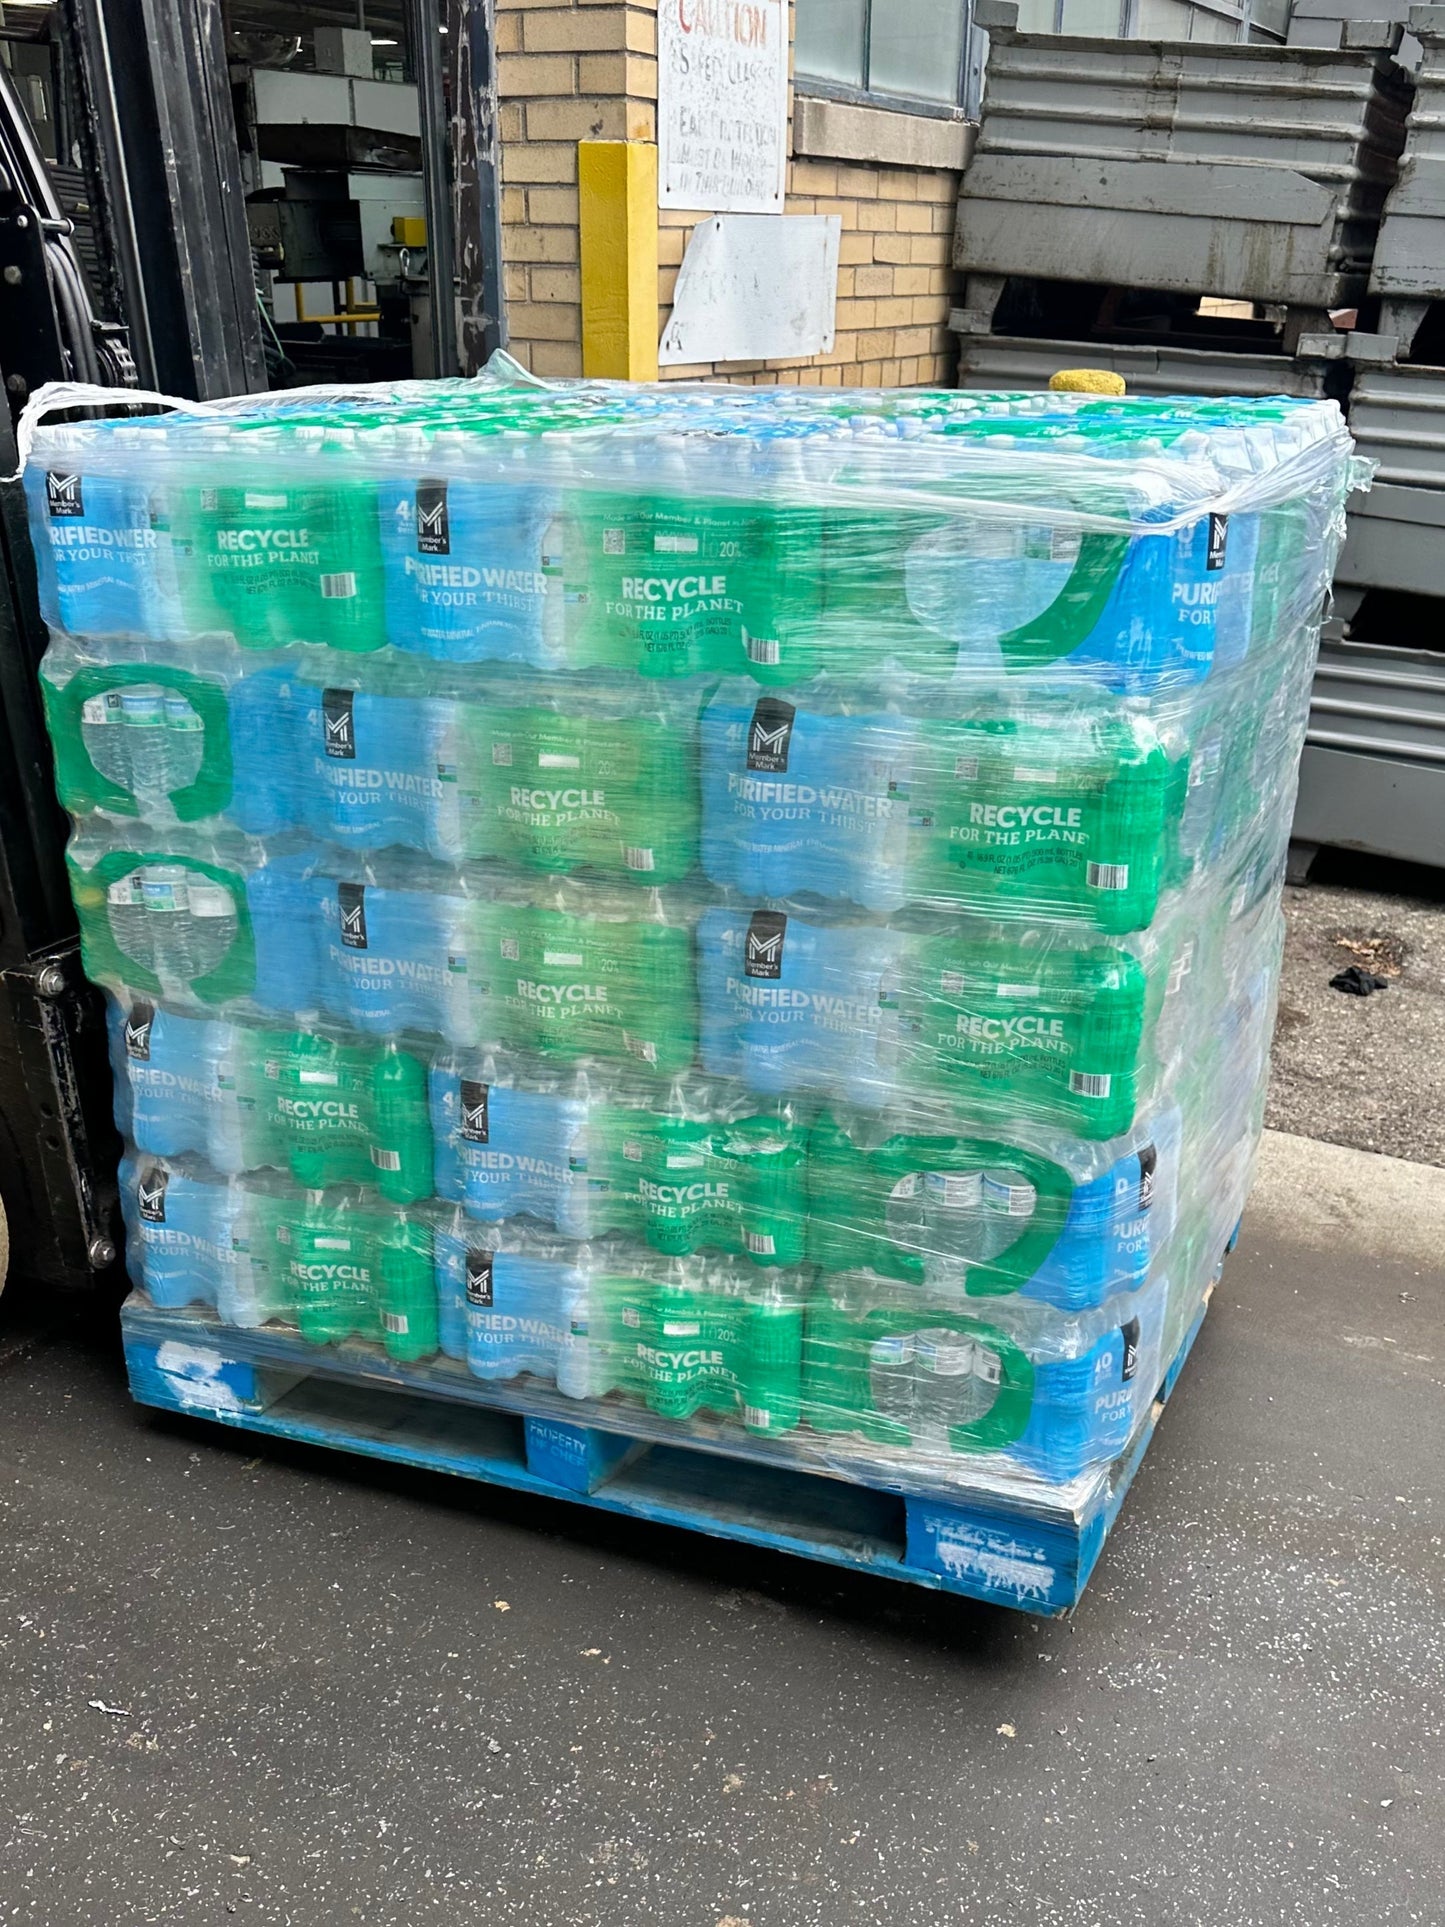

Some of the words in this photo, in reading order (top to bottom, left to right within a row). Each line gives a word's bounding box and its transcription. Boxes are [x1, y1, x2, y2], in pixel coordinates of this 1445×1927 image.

[679, 0, 767, 49] CAUTION
[655, 512, 692, 523] Member
[703, 518, 730, 527] Planet
[217, 528, 309, 551] RECYCLE
[419, 535, 447, 544] ember's
[422, 543, 438, 552] Mark
[67, 548, 114, 562] YOUR
[207, 553, 229, 567] FOR
[231, 553, 264, 567] THE
[268, 551, 319, 566] PLANET
[482, 568, 548, 594] WATER
[622, 576, 727, 601] RECYCLE
[431, 591, 477, 606] YOUR
[482, 591, 534, 612] THIRST
[606, 602, 632, 617] FOR
[636, 605, 666, 621] THE
[672, 598, 744, 621] PLANET
[1178, 609, 1211, 625] FOR
[328, 748, 344, 756] Mark
[750, 752, 785, 763] Member's
[755, 760, 775, 770] Mark
[384, 771, 444, 798] WATER
[338, 790, 381, 805] YOUR
[511, 786, 605, 810] RECYCLE
[728, 773, 817, 804] PURIFIED
[819, 788, 893, 819] WATER
[497, 806, 521, 822] FOR
[523, 812, 550, 827] THE
[556, 808, 620, 827] PLANET
[734, 801, 756, 820] FOR
[760, 808, 811, 821] YOUR
[817, 810, 876, 834] THIRST
[970, 802, 1082, 828] RECYCLE
[950, 826, 979, 842] FOR
[984, 830, 1020, 845] THE
[396, 960, 454, 987] WATER
[751, 967, 770, 977] Mark
[353, 977, 393, 990] YOUR
[516, 979, 608, 1004] RECYCLE
[530, 1003, 555, 1019] THE
[560, 1003, 624, 1020] PLANET
[757, 1010, 804, 1024] YOUR
[811, 995, 883, 1024] WATER
[956, 1014, 1064, 1040] RECYCLE
[938, 1033, 965, 1050] FOR
[970, 1039, 1004, 1054] THE
[137, 1087, 174, 1099] YOUR
[278, 1096, 359, 1119] RECYCLE
[288, 1117, 315, 1130] THE
[472, 1170, 511, 1184] YOUR
[516, 1155, 574, 1185] WATER
[639, 1178, 729, 1204] RECYCLE
[650, 1202, 676, 1218] THE
[681, 1199, 744, 1218] PLANET
[150, 1245, 190, 1257] YOUR
[1118, 1239, 1142, 1254] FOR
[290, 1260, 370, 1282] RECYCLE
[302, 1281, 329, 1293] THE
[476, 1330, 515, 1344] YOUR
[518, 1317, 576, 1348] WATER
[637, 1343, 724, 1370] RECYCLE
[624, 1357, 647, 1372] FOR
[649, 1366, 673, 1383] THE
[677, 1366, 739, 1384] PLANET
[1102, 1408, 1126, 1423] FOR
[530, 1421, 586, 1455] PROPERTY
